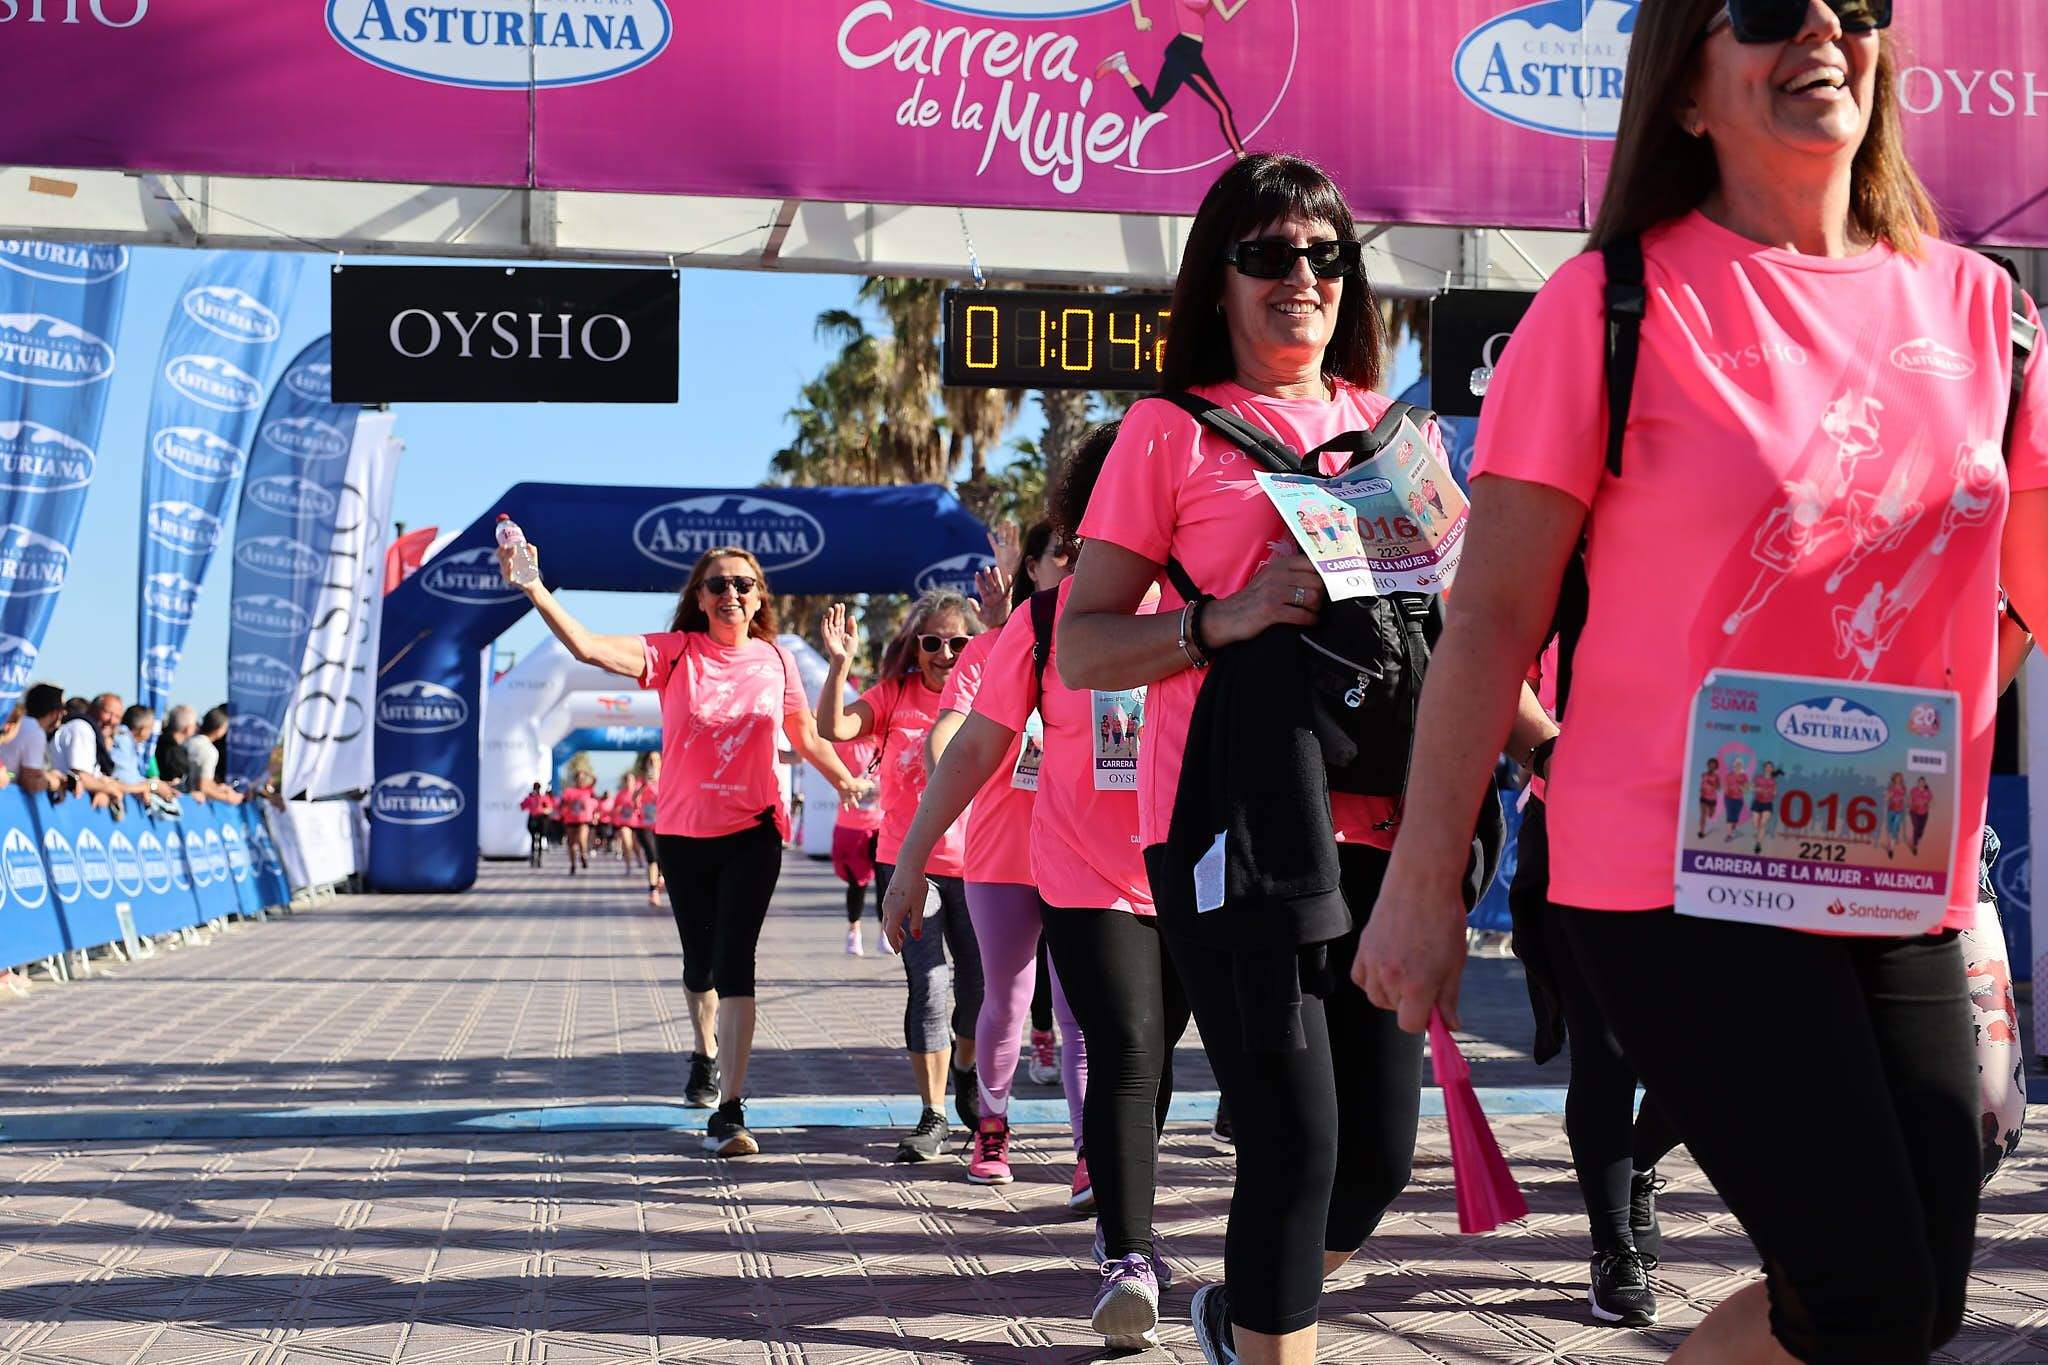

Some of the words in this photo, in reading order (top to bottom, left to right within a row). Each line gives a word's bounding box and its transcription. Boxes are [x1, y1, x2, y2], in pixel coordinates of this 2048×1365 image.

[354, 0, 644, 50] ASTURIANA
[837, 2, 1078, 80] Carrera
[896, 78, 940, 129] de
[952, 83, 983, 130] la
[977, 80, 1168, 194] Mujer
[389, 308, 632, 361] OYSHO
[650, 518, 810, 554] ASTURIANA
[1326, 560, 1369, 571] CARRERA
[1370, 560, 1382, 570] DE
[1383, 560, 1393, 570] LA
[1395, 555, 1430, 570] MUJER
[1435, 516, 1468, 557] VALENCIA
[1354, 516, 1418, 541] 016
[1377, 545, 1410, 559] 2238
[1346, 575, 1397, 590] OYHO
[1784, 713, 1882, 743] ASTURIANA
[1102, 759, 1135, 769] CARRERA
[1779, 789, 1878, 835] 016
[1798, 842, 1847, 862] 2212
[1694, 854, 1763, 877] CARRERA
[1767, 862, 1786, 880] DE
[1791, 864, 1811, 882] LA
[1814, 865, 1861, 885] MUJER
[1873, 872, 1934, 891] VALENCIA
[1708, 886, 1795, 911] OYSHO
[1849, 902, 1920, 921] Santander
